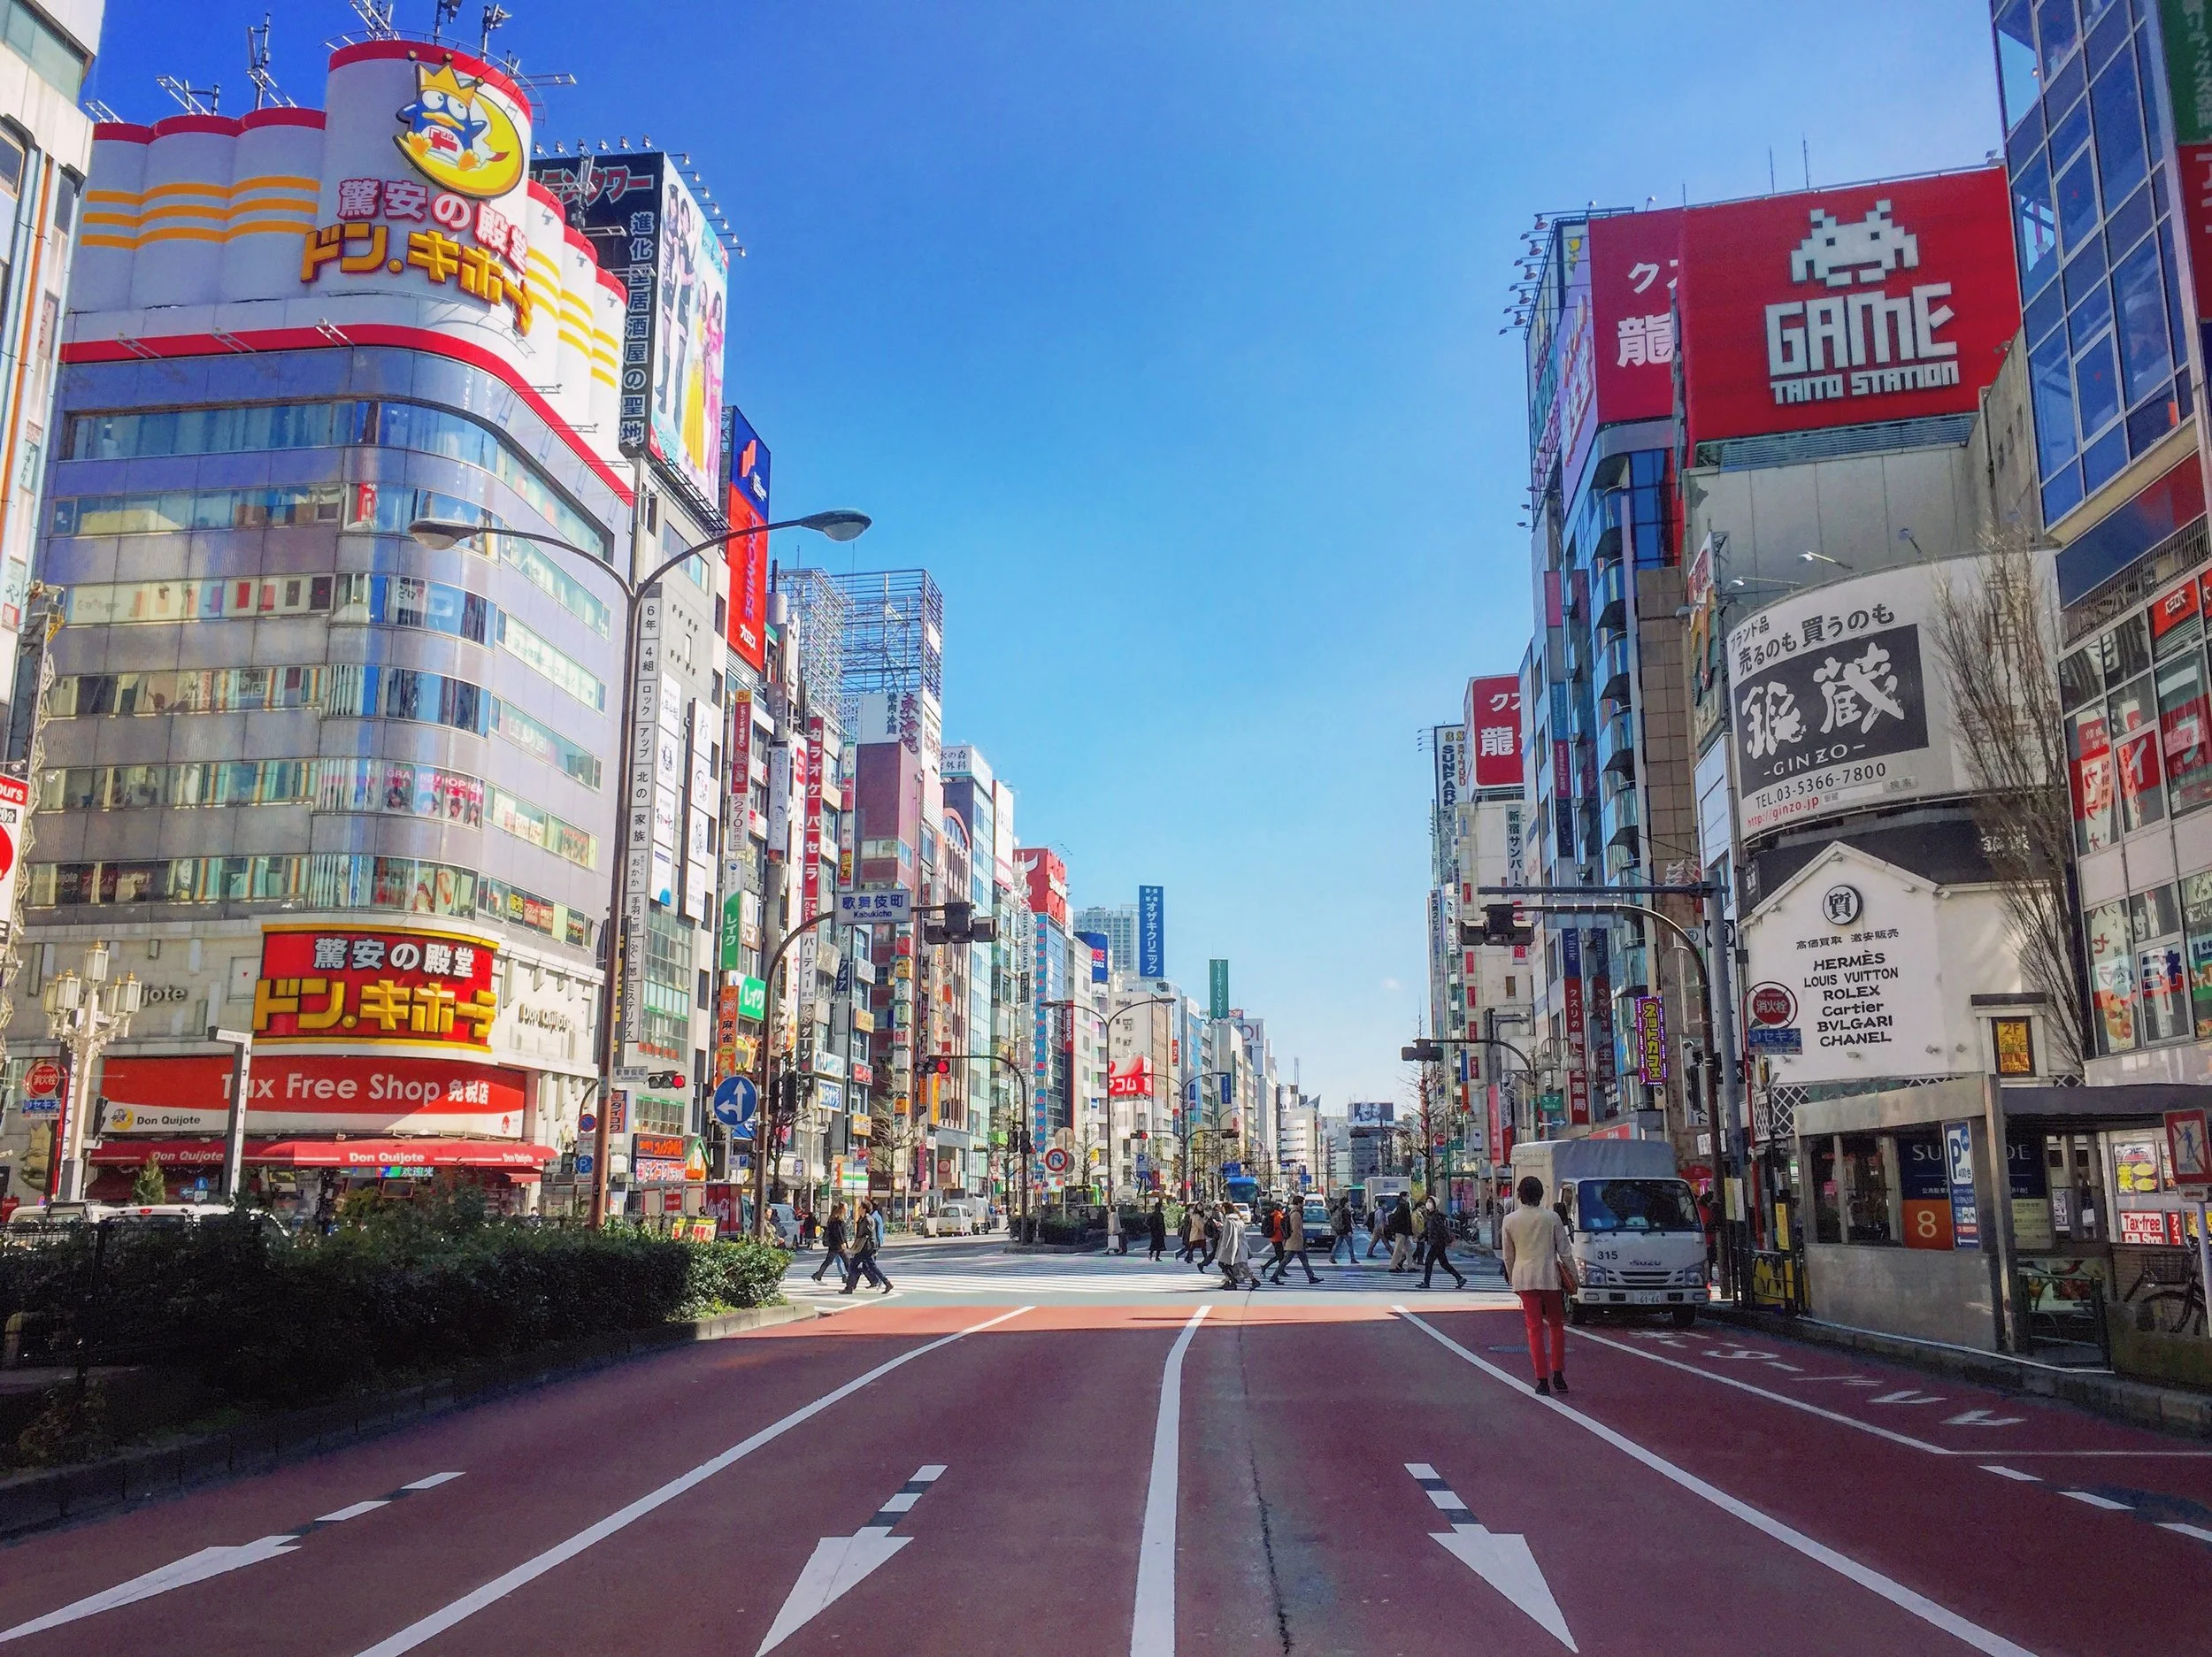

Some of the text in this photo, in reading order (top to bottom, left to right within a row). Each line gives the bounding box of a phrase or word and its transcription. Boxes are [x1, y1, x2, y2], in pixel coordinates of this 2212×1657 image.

[528, 165, 654, 207] ランタワー
[337, 178, 529, 276] 驚安の殿堂
[1766, 281, 1958, 377] GAME
[1771, 360, 1960, 404] TAITO STATION
[1731, 615, 1770, 653] ブランド品
[737, 693, 750, 703] 8F
[1741, 642, 1905, 760] 銀蔵
[639, 685, 652, 759] ロックアップ
[1479, 725, 1515, 757] 龍
[1441, 745, 1456, 807] SUNPARK
[634, 771, 649, 841] 北の家族
[1747, 795, 1819, 828] http://ginzo.jp
[842, 894, 904, 910] 歌舞伎町
[853, 909, 893, 921] Kabukicho
[1828, 891, 1853, 919] 質
[726, 914, 739, 947] レイク
[1146, 902, 1158, 975] オザキクリニック
[1796, 928, 1900, 950] 高価買取 激安販売
[314, 937, 474, 978] 驚安の殿堂
[803, 938, 814, 989] パーティー
[1813, 950, 1886, 972] HERMÈS
[836, 960, 849, 988] 747
[1804, 967, 1899, 988] LOUIS VUITTON
[744, 986, 765, 1012] レイク
[1756, 1000, 1787, 1014] 消火栓
[1823, 985, 1881, 1001] ROLEX
[520, 1005, 540, 1024] Don
[625, 983, 636, 1039] ミステリアス
[1822, 1001, 1885, 1017] Cartier
[721, 1019, 735, 1045] 麻雀
[1817, 1016, 1893, 1033] BVLGARI
[2003, 1024, 2020, 1035] 2F
[1644, 1002, 1662, 1078] ネットカフェ
[1819, 1031, 1892, 1047] CHANEL
[32, 1074, 58, 1086] 消火栓
[286, 1073, 357, 1100] Free
[368, 1073, 440, 1107] Shop
[447, 1078, 489, 1105] 免税店
[137, 1115, 201, 1126] Don Quijote
[151, 1150, 224, 1162] Don Quijote
[349, 1152, 425, 1164] Don Quijote
[1949, 1138, 1962, 1180] P
[1916, 1210, 1938, 1239] 8
[1597, 1250, 1618, 1261] 315
